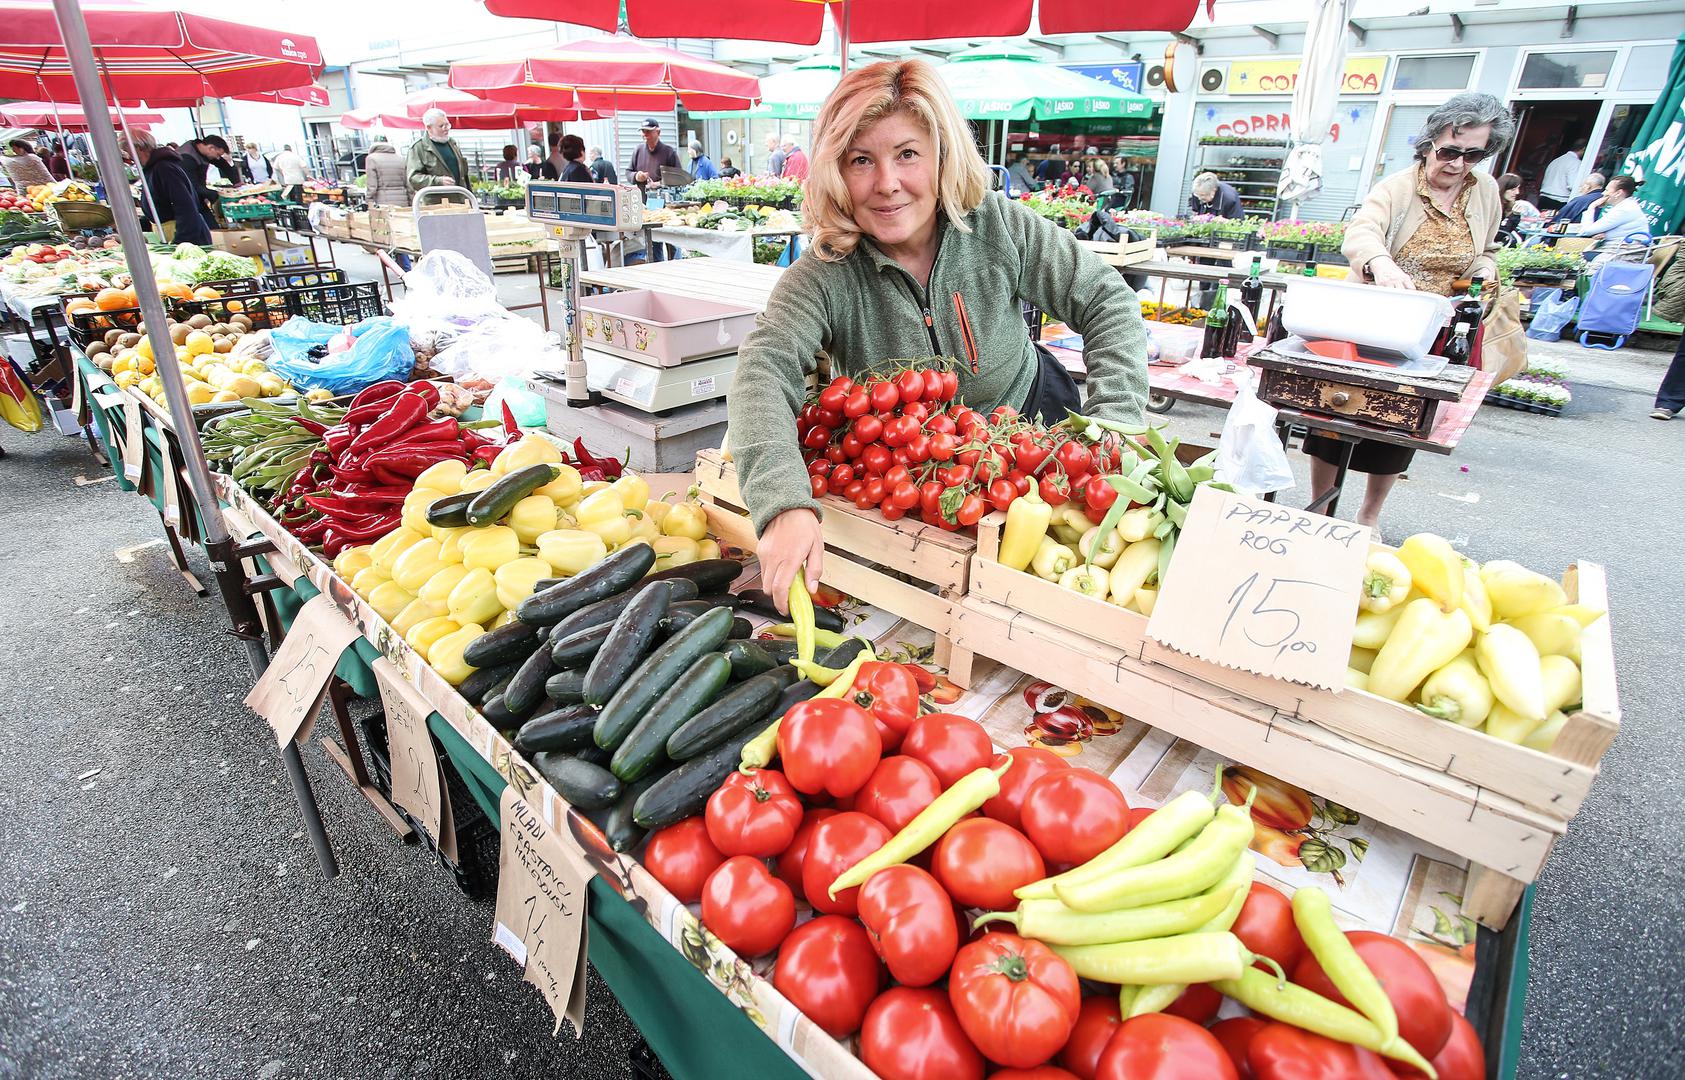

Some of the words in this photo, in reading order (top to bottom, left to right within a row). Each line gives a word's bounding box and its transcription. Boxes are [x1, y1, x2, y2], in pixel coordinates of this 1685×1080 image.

[1216, 112, 1340, 143] COPRNA
[1635, 197, 1664, 217] ATER
[1225, 502, 1361, 548] PAPRIKA
[1240, 530, 1294, 556] ROG
[510, 798, 546, 841] MLADI
